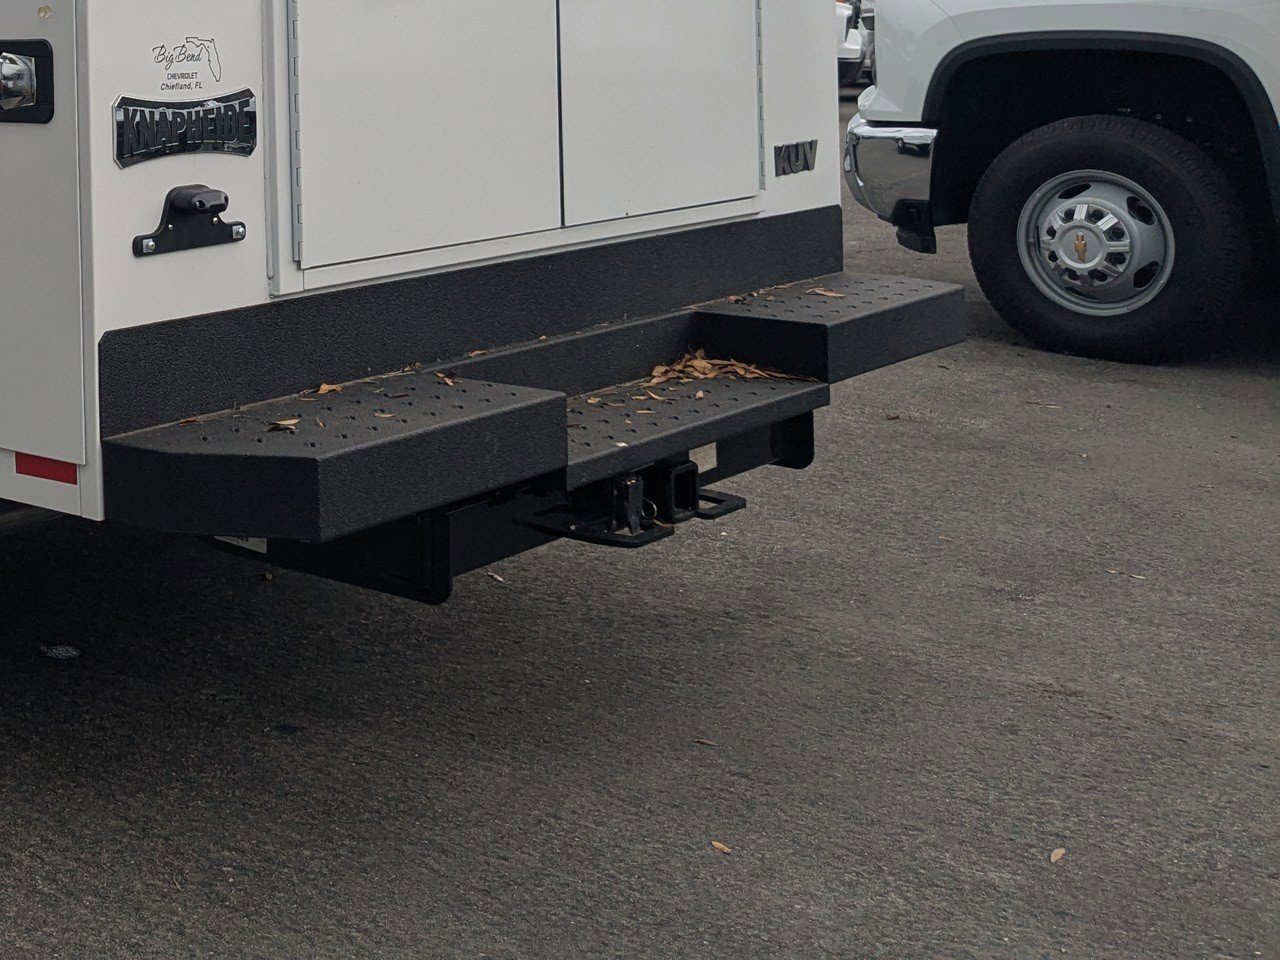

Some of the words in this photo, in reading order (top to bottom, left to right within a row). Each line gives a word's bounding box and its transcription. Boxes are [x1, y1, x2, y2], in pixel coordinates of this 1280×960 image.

[152, 44, 174, 70] Big
[173, 44, 203, 63] Bend
[167, 72, 198, 80] CHEVROLET
[121, 97, 253, 157] KNAPHEIDE
[774, 139, 818, 178] KUV
